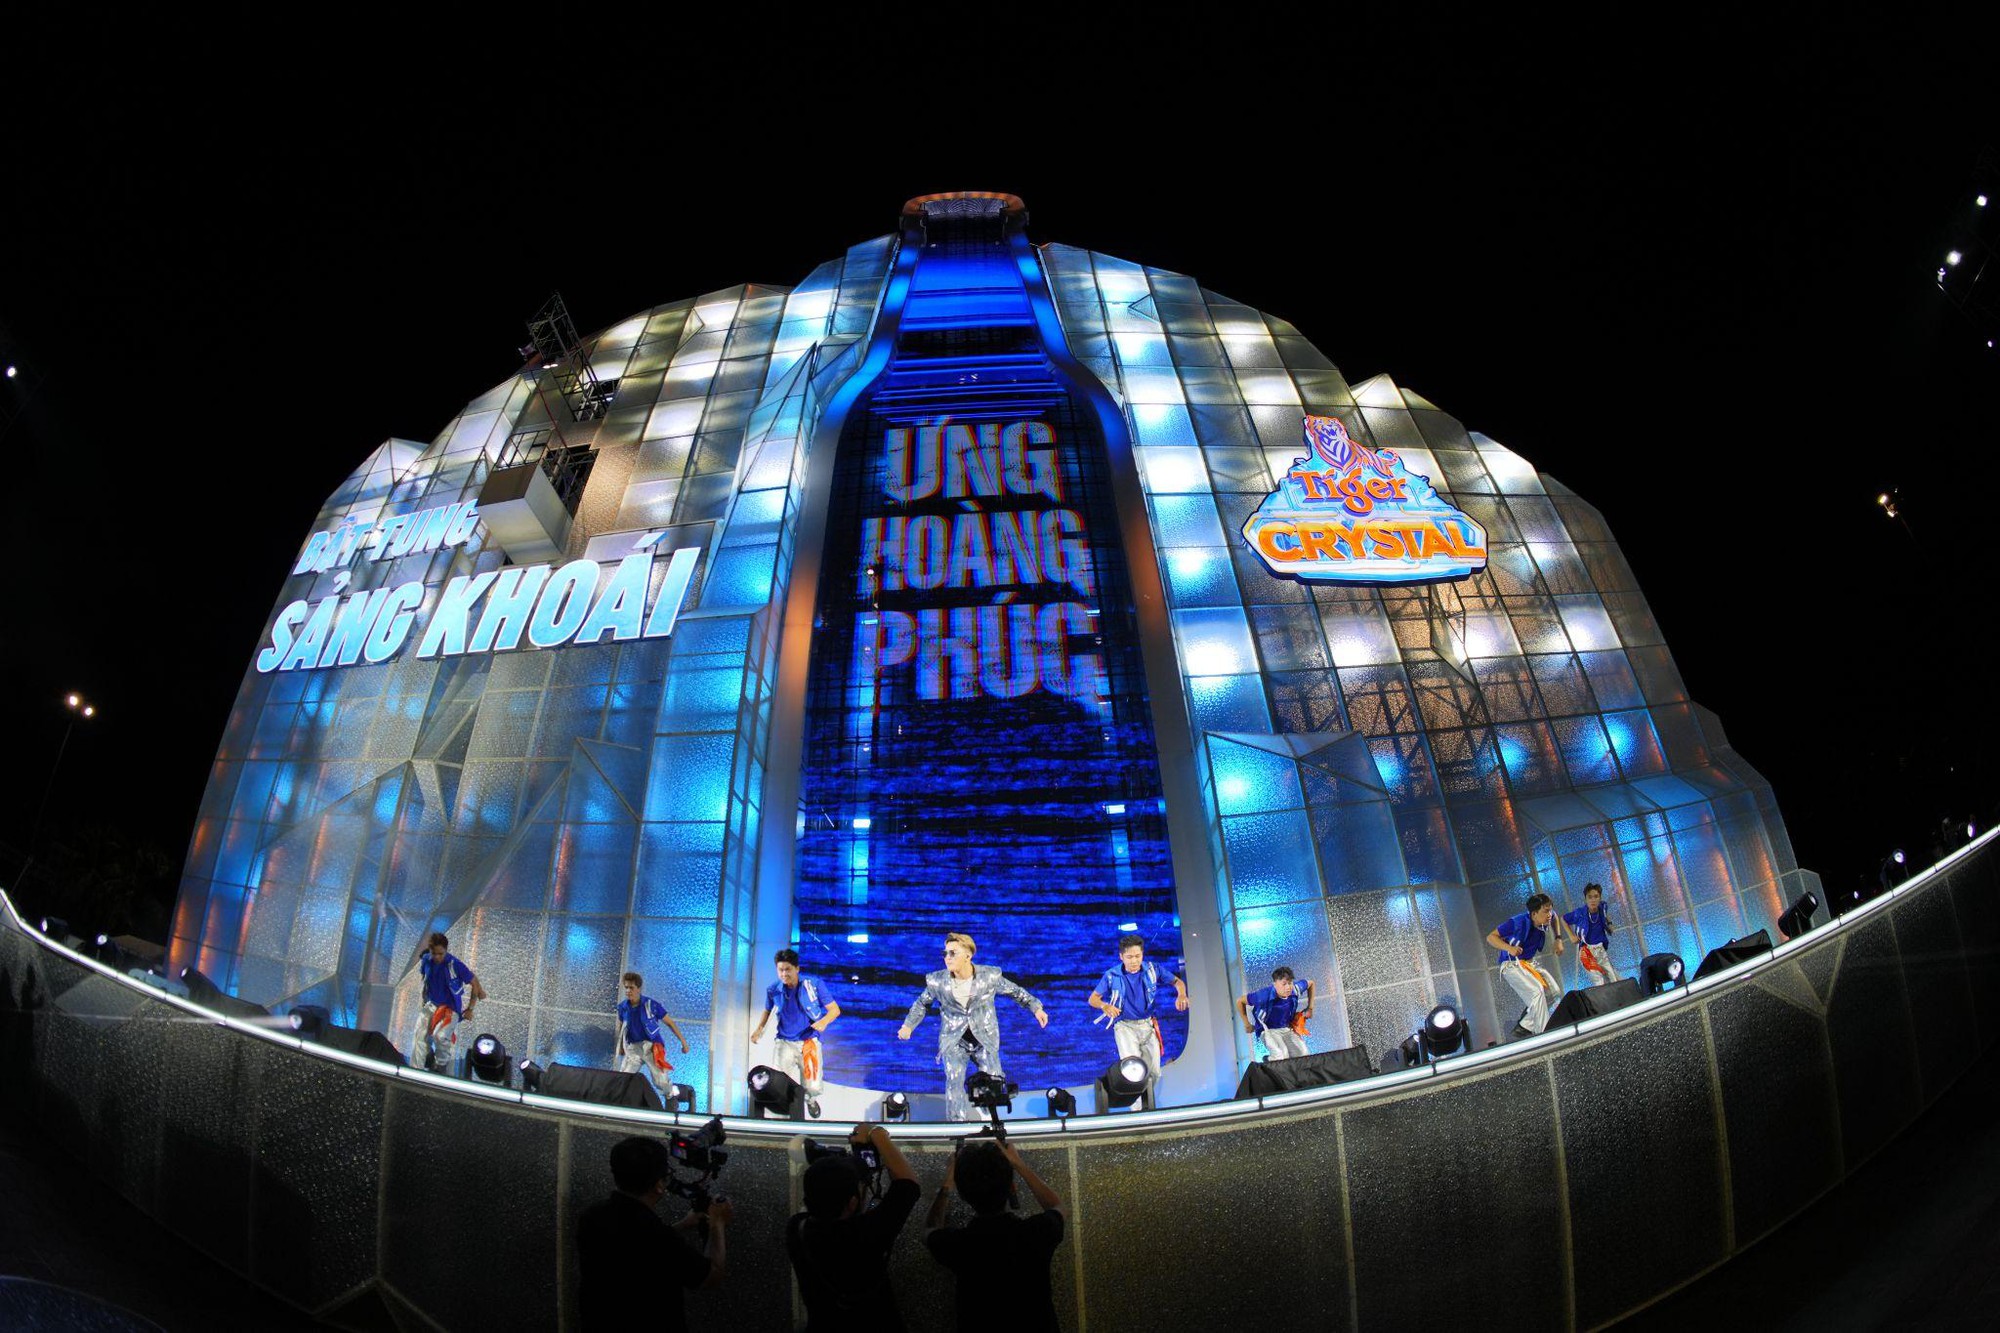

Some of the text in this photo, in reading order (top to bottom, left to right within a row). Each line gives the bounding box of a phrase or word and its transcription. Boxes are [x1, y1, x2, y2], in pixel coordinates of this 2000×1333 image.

[1291, 468, 1407, 514] Tiger
[293, 499, 480, 575] BẬT TUNG
[857, 500, 1096, 599] HOÀNG
[1258, 519, 1487, 562] CRYSTAL
[257, 532, 701, 673] SẢNG KHOÁI
[852, 591, 1106, 703] PHÚC
